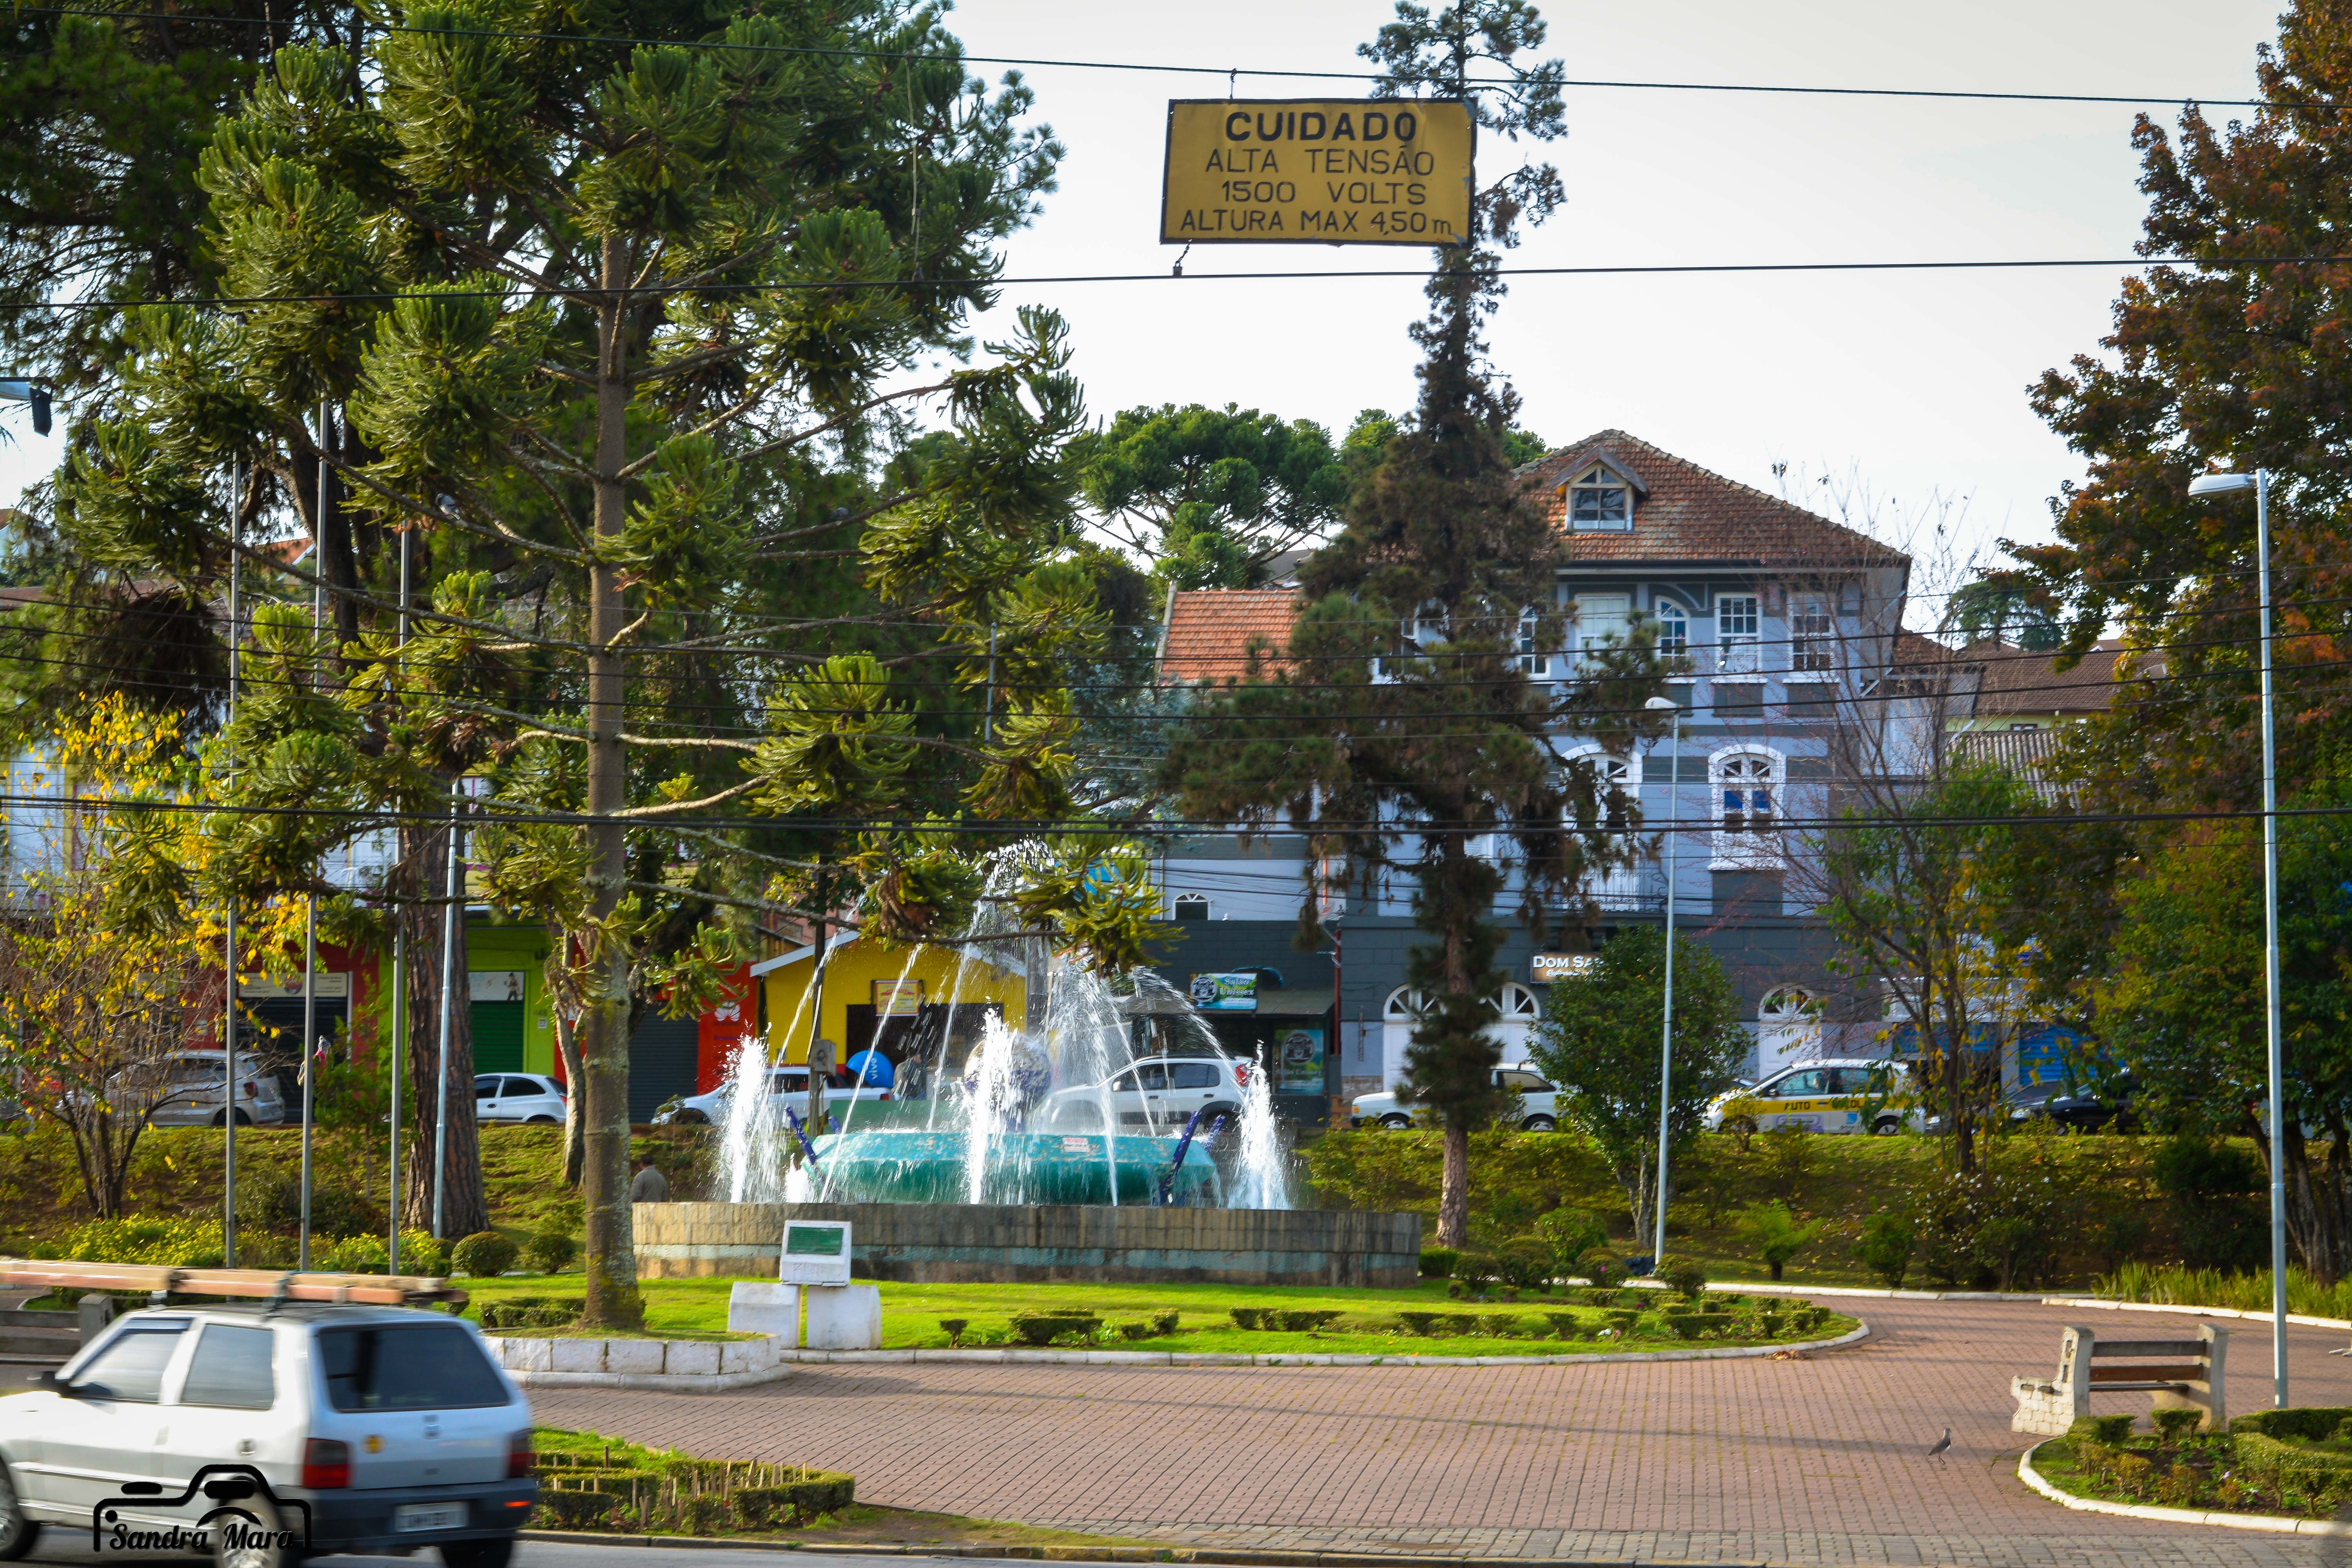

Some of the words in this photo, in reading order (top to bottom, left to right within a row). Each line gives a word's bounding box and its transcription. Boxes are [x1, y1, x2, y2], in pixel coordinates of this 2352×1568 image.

[1226, 112, 1416, 142] CUIDADO
[1205, 149, 1279, 173] ALTA
[1305, 145, 1434, 175] TENSÃO
[1222, 181, 1296, 203] 1500
[1327, 183, 1426, 206] VOLTS
[1180, 210, 1284, 231] ALTURA
[1301, 211, 1358, 232] MAX
[1220, 987, 1254, 995] Unissex
[1224, 976, 1249, 985] Salão
[868, 1058, 878, 1080] vivo
[1784, 1101, 1811, 1111] AUTO
